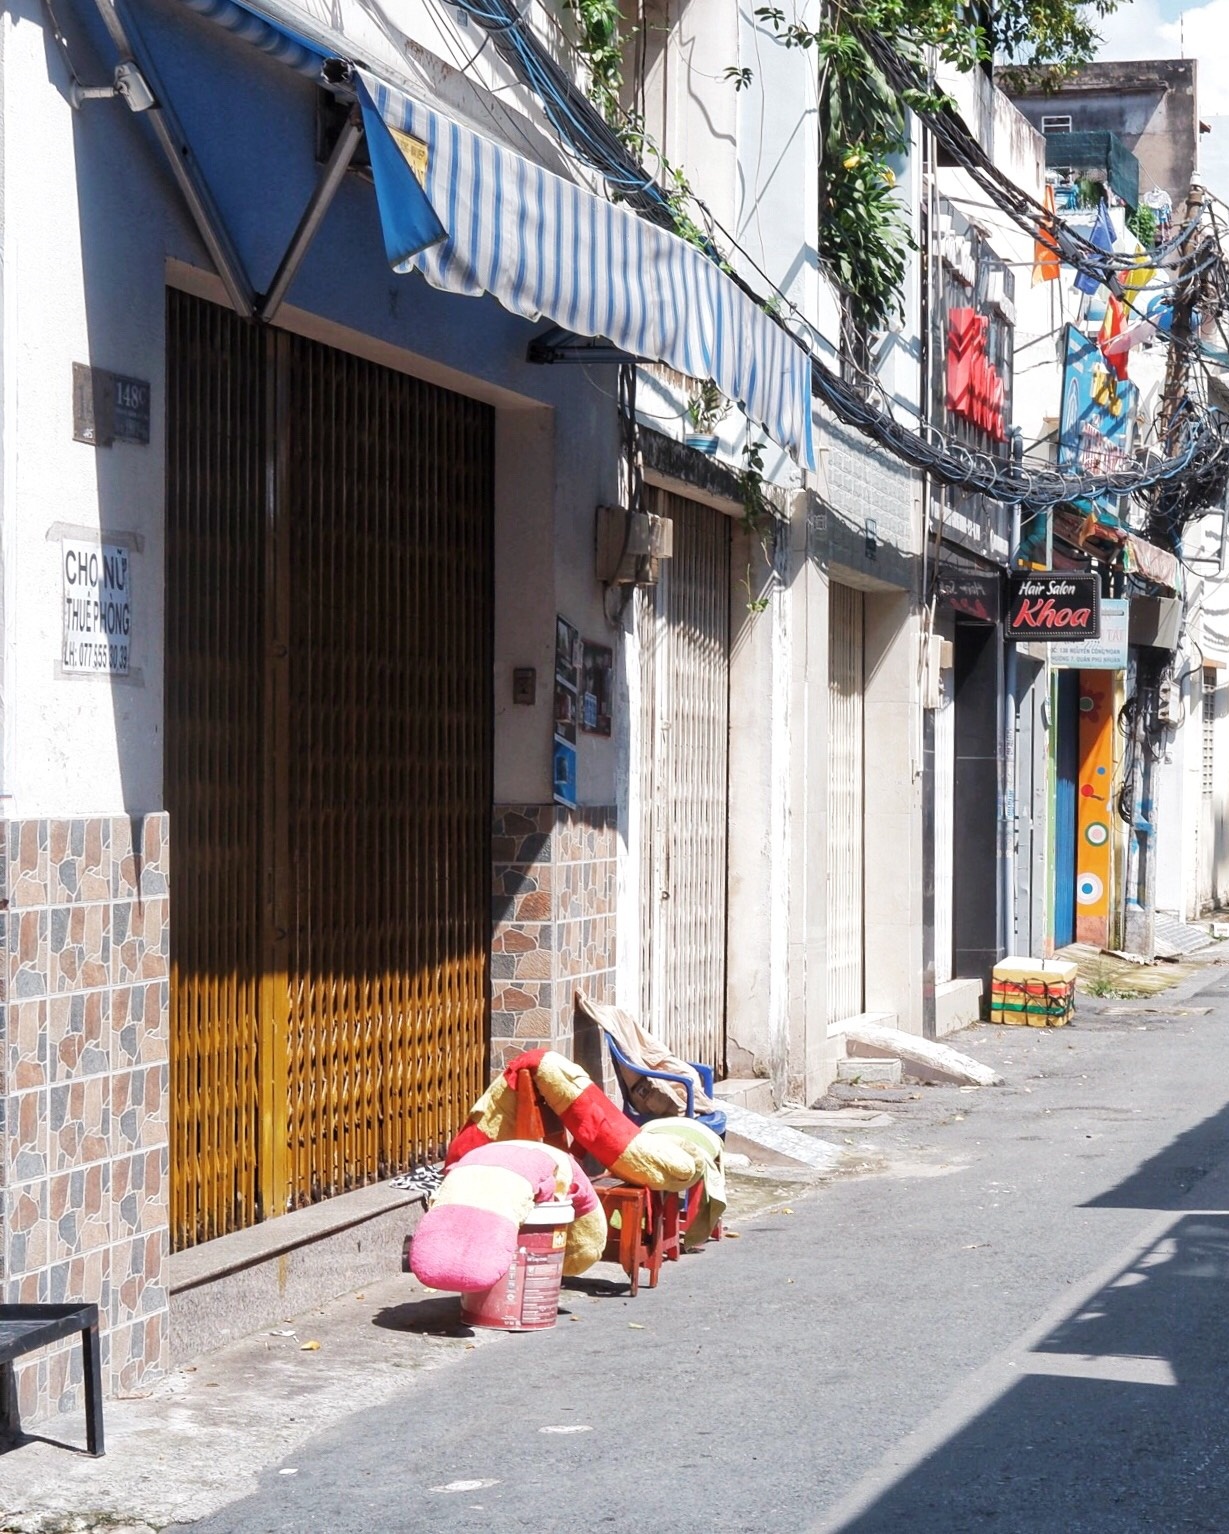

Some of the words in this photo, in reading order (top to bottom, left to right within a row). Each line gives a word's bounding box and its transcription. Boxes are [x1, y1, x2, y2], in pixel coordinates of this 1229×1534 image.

[65, 549, 98, 588] CHO
[104, 548, 127, 591] NỮ
[1019, 580, 1045, 596] Hair
[1046, 580, 1076, 596] Salon
[66, 591, 92, 632] THUÊ
[94, 594, 129, 636] PHÒNG
[1012, 598, 1092, 629] Khoa
